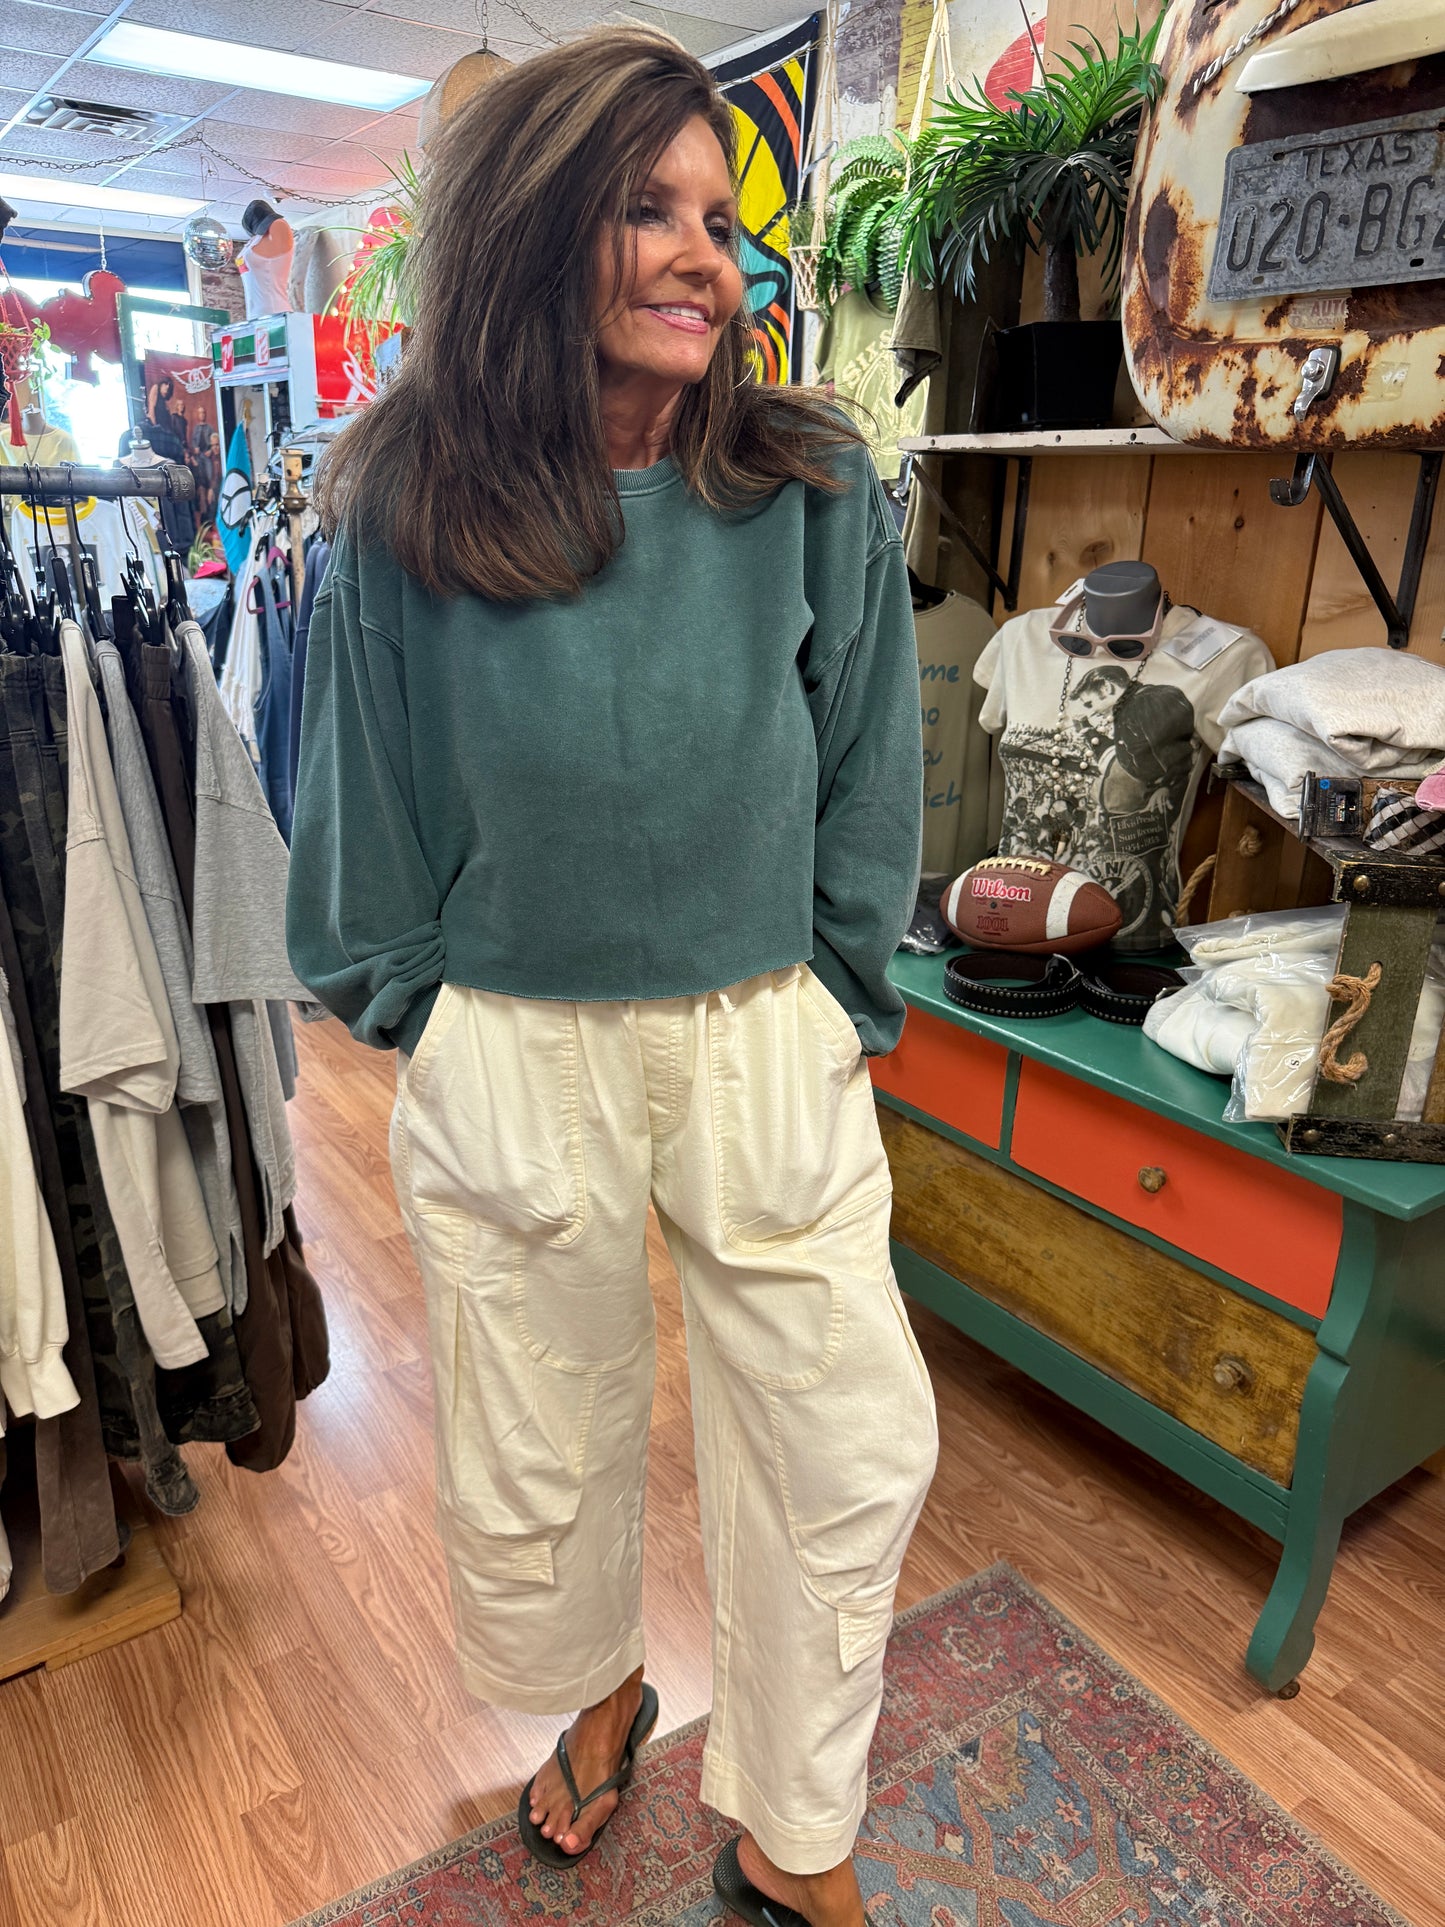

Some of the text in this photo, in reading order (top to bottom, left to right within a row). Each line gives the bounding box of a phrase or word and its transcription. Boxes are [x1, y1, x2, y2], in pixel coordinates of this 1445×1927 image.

[1302, 134, 1413, 180] TEXAS
[1118, 833, 1136, 843] Sun
[1088, 861, 1120, 879] UN
[971, 877, 1031, 902] Wilson
[976, 915, 1009, 932] 1001
